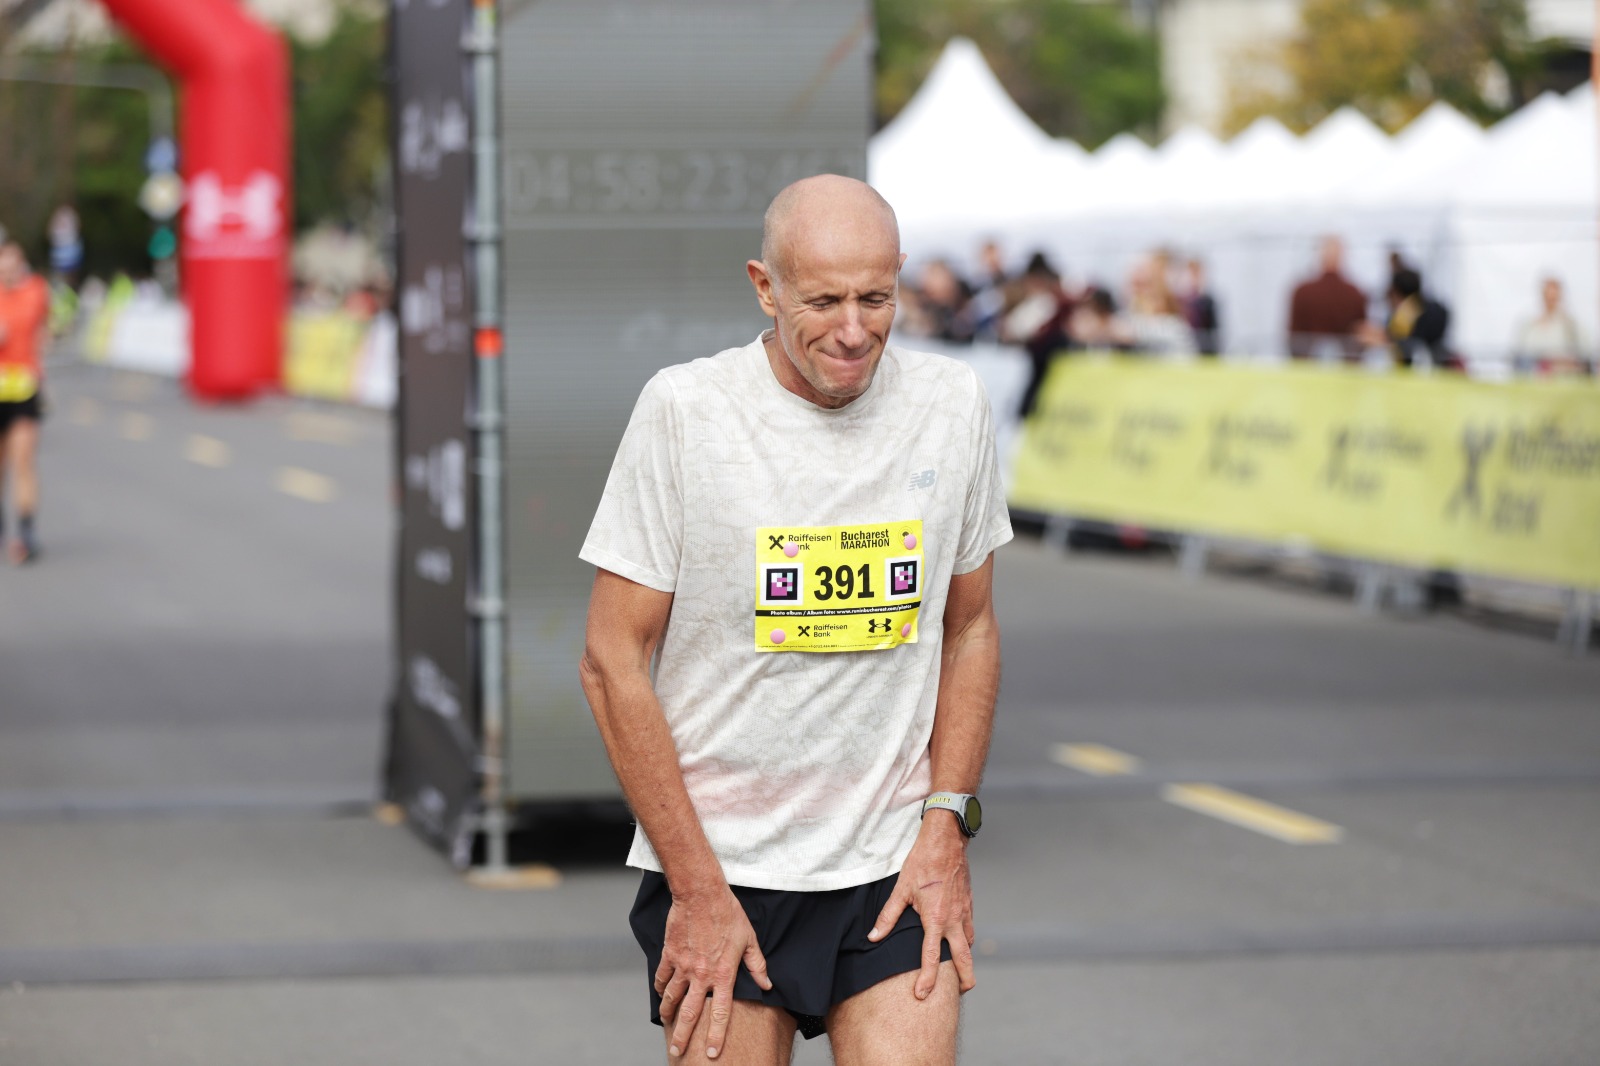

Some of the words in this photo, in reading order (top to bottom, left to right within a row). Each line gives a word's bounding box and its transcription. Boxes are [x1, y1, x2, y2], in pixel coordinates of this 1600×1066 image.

[788, 534, 832, 542] Raiffeisen
[841, 528, 889, 541] Bucharest
[840, 538, 890, 550] MARATHON
[813, 563, 875, 601] 391
